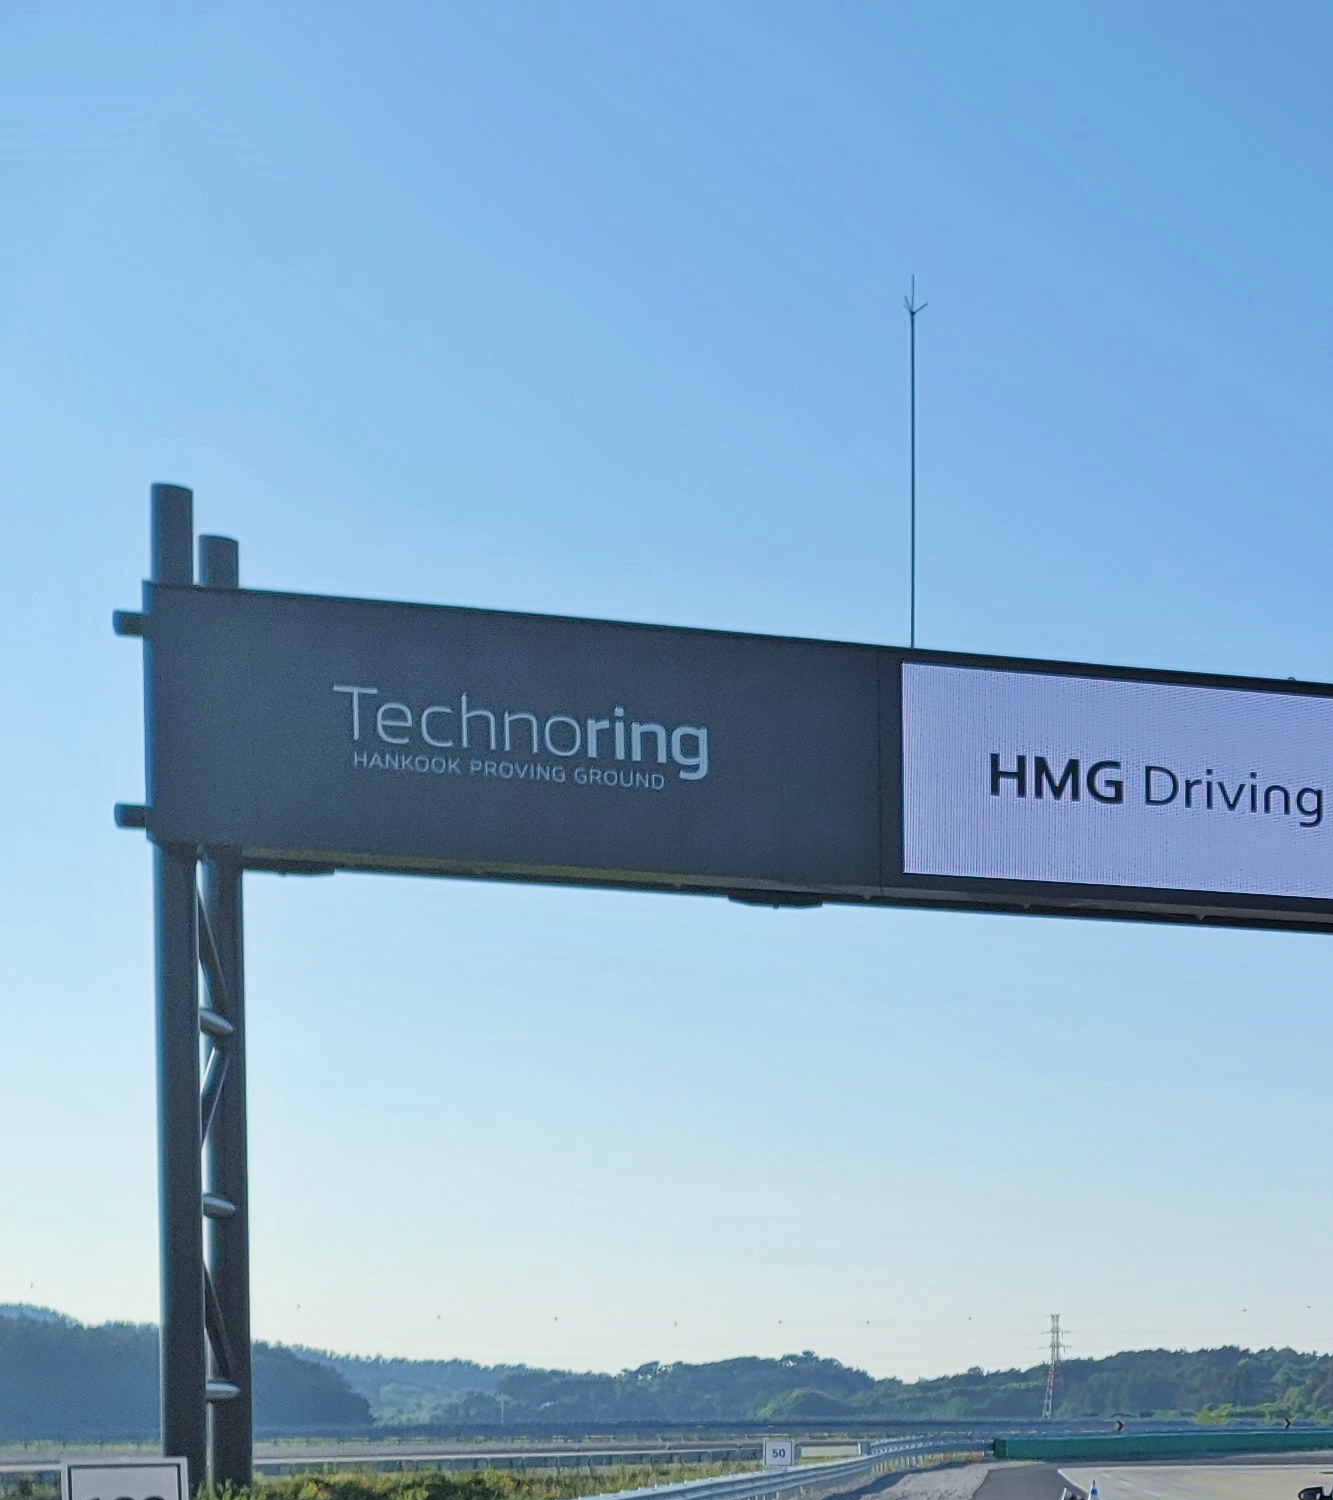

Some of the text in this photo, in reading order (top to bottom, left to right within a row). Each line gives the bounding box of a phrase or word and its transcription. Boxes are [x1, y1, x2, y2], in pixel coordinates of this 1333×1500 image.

[333, 685, 709, 780] Technoring
[353, 750, 666, 791] HANKOOK PROVING GROUND
[989, 752, 1124, 805] HMG
[1144, 763, 1324, 828] Driving
[772, 1448, 786, 1458] 50
